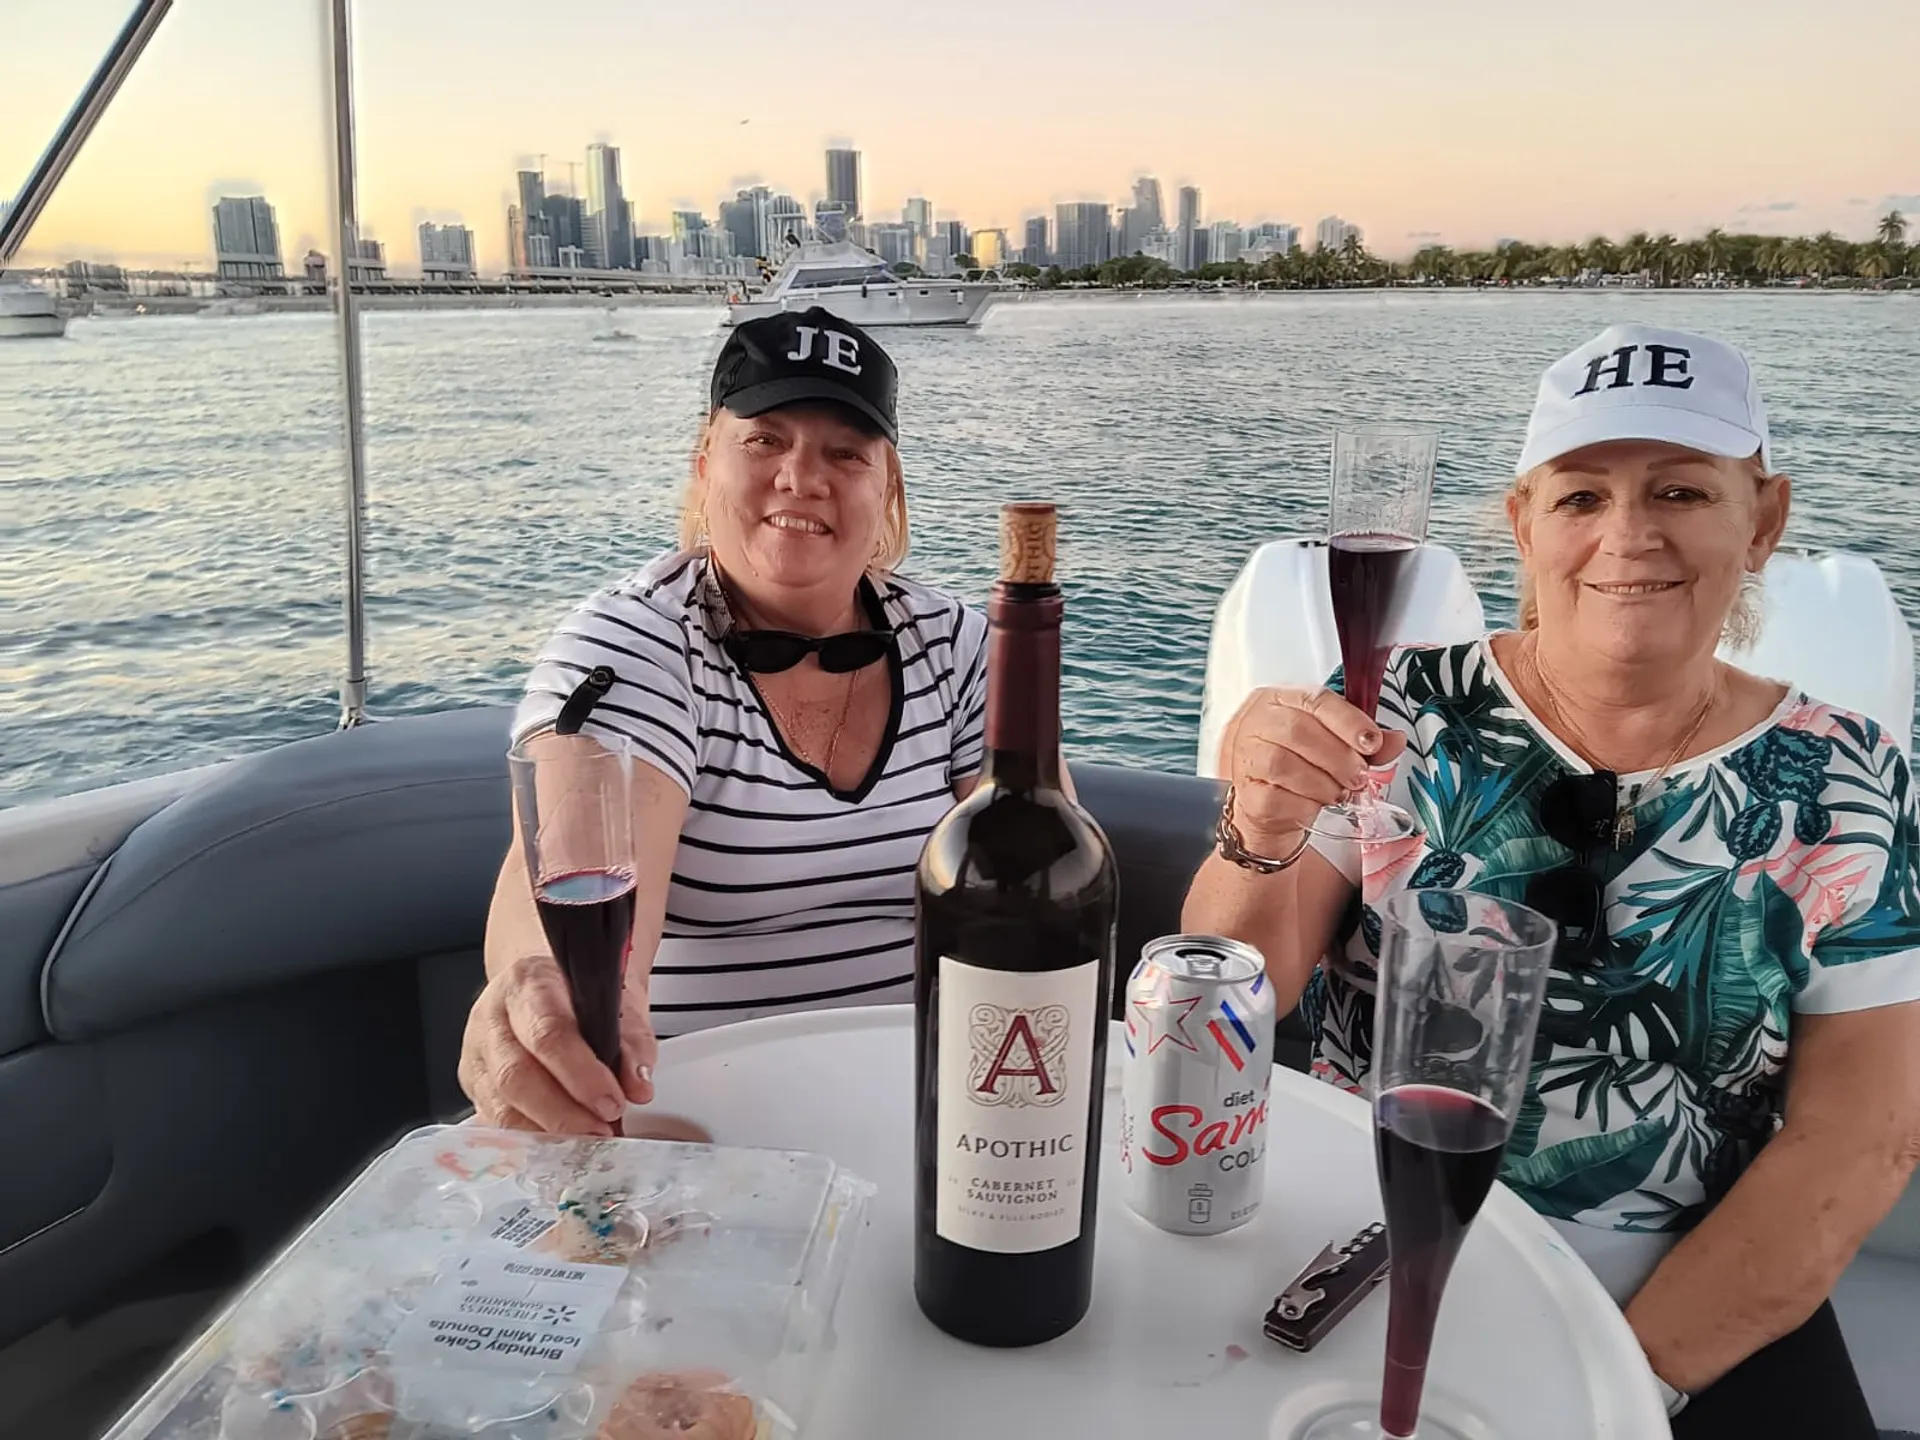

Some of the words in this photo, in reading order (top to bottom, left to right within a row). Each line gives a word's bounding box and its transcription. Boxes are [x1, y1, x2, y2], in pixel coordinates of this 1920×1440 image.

[787, 326, 862, 376] JE
[1570, 344, 1695, 399] HE
[976, 1014, 1058, 1096] A
[1223, 1089, 1255, 1108] diet
[1142, 1099, 1267, 1167] Sam
[956, 1133, 1074, 1159] APOTHIC
[971, 1177, 1056, 1193] CABERNET
[966, 1189, 1059, 1205] SAUVIGNON
[429, 1319, 495, 1337] Donuts
[497, 1327, 538, 1342] Mini
[434, 1334, 481, 1351] Cake
[484, 1339, 564, 1360] Birthday
[540, 1333, 581, 1347] Iced
